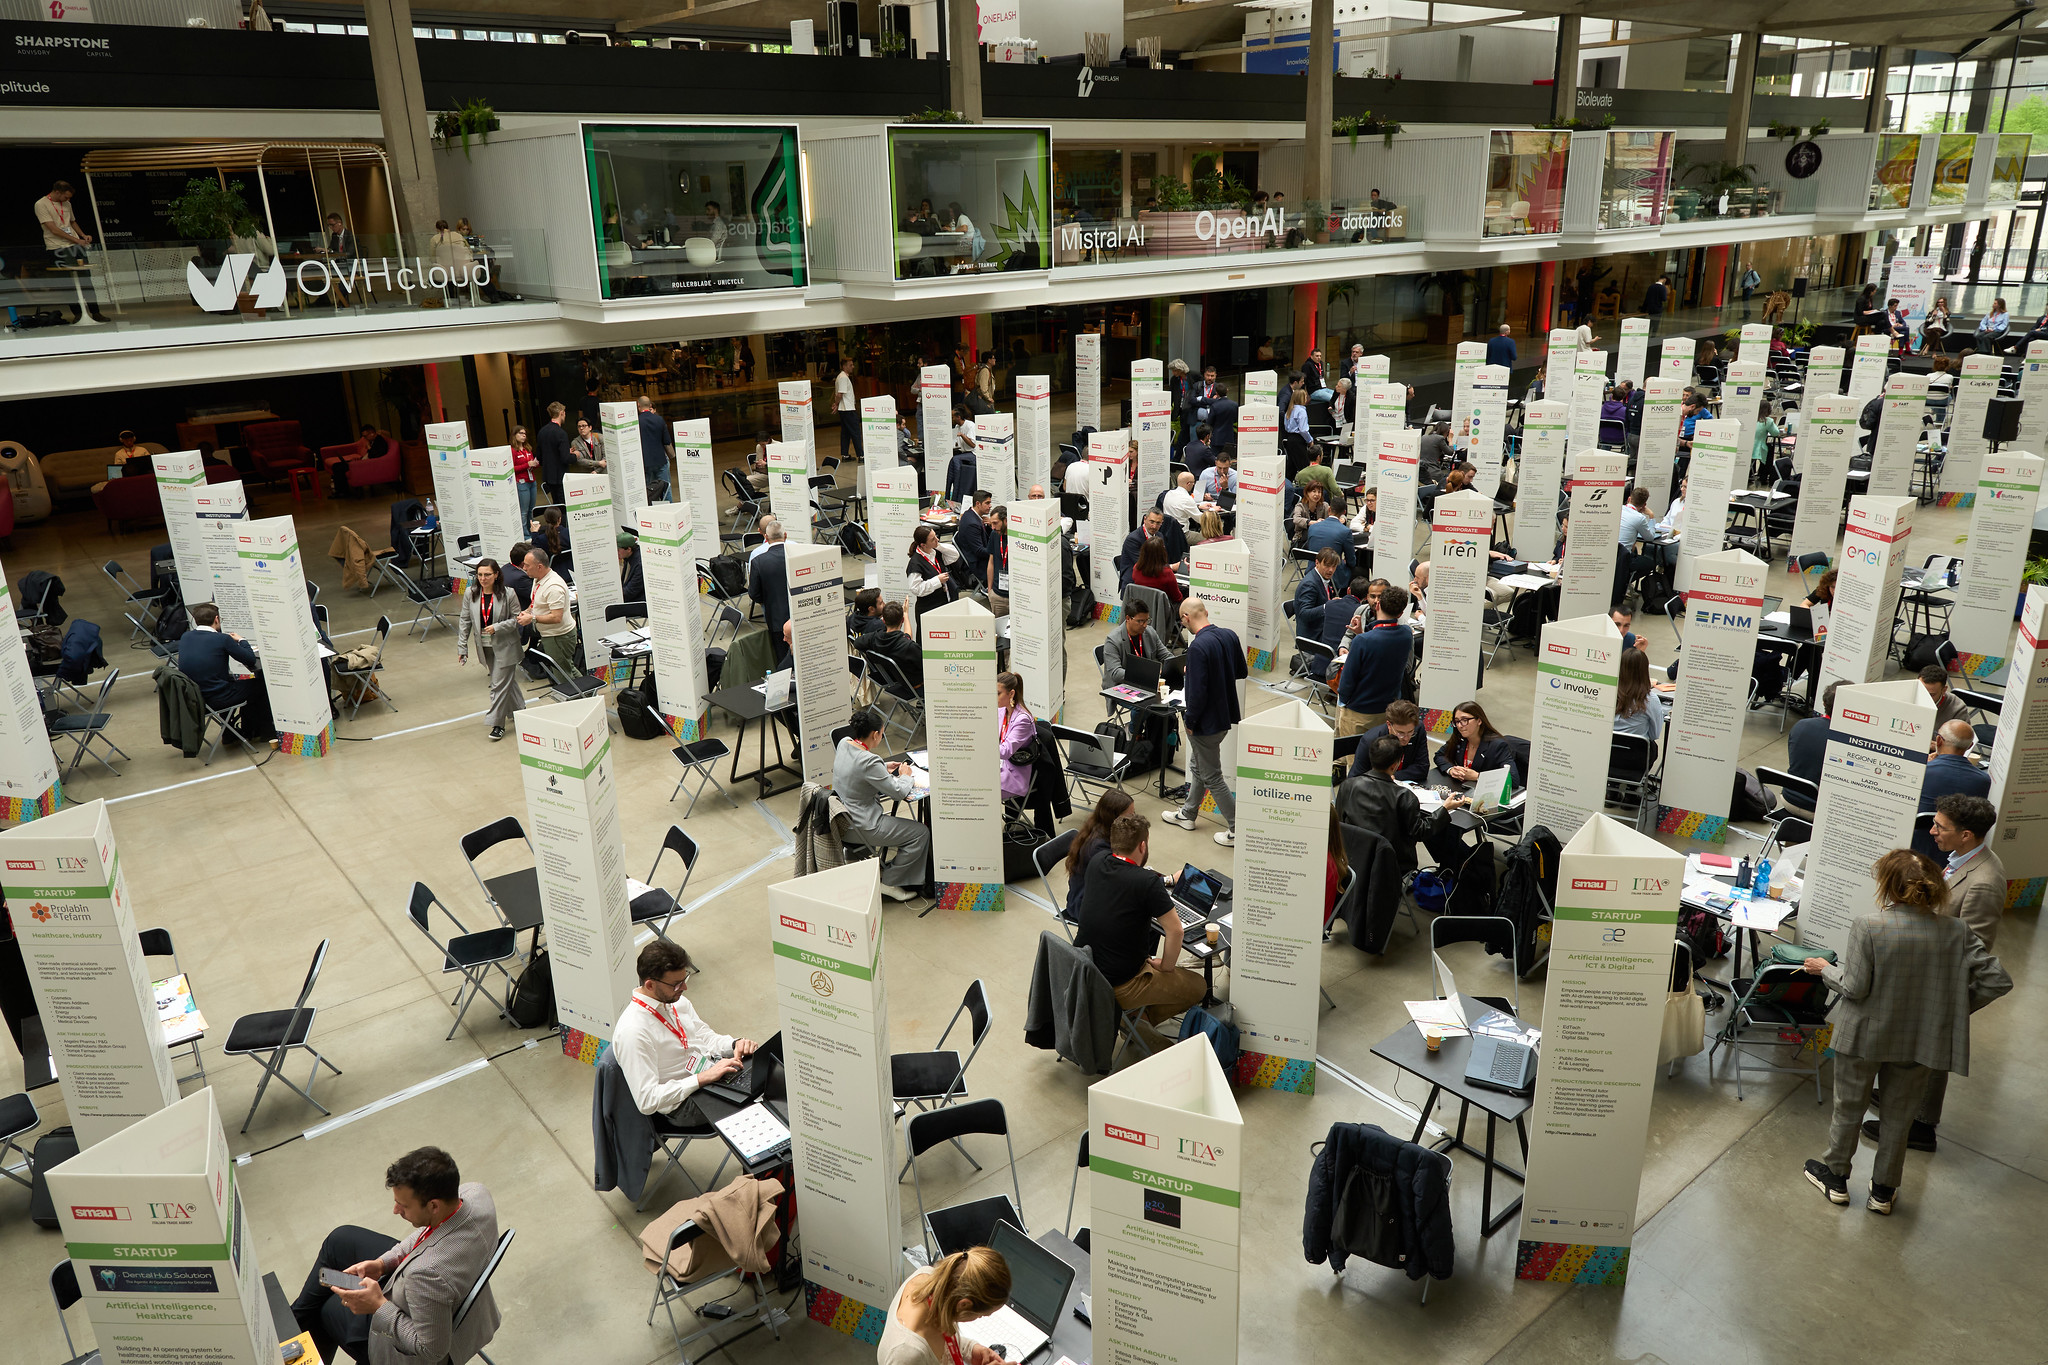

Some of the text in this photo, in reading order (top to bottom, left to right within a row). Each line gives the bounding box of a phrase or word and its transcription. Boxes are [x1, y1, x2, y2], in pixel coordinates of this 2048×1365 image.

[982, 10, 1017, 25] ONEFLASH
[15, 35, 110, 49] SHARPSTONE
[0, 80, 50, 94] plitude
[1576, 90, 1613, 107] Biolevate
[1194, 207, 1284, 248] OpenAI
[1341, 211, 1403, 231] databricks
[1061, 224, 1145, 251] Mistral AI
[978, 261, 999, 269] TRAMWAY
[296, 253, 491, 297] OVHcloud
[671, 279, 713, 289] ROLLERBLADE
[717, 277, 745, 287] UNICYCLE
[1386, 455, 1409, 463] CORPORATE
[1384, 471, 1408, 479] LACTALIS
[478, 479, 495, 487] TMT
[1246, 484, 1268, 492] CORPORATE
[2001, 493, 2024, 501] Butterfly
[1855, 527, 1881, 539] CORPORATE
[1443, 544, 1477, 558] iren
[1847, 545, 1881, 567] enel
[802, 580, 834, 593] INSTITUTION
[1205, 581, 1231, 589] STARTUP
[1196, 592, 1240, 605] MatchGuru
[1704, 593, 1747, 604] CORPORATE
[1711, 612, 1752, 629] FNM
[1718, 626, 1750, 634] movimento
[944, 664, 975, 673] BIOTECH
[1560, 668, 1593, 680] STARTUP
[1542, 701, 1605, 719] Emerging Technologies
[1545, 696, 1602, 713] Artificial Intelligence,
[1844, 710, 1916, 733] smau ITA
[1249, 745, 1318, 759] smau ITA
[1848, 736, 1905, 757] INSTITUTION
[537, 760, 564, 774] STARTUP
[1846, 751, 1901, 771] REGIONE LAZIO
[1264, 771, 1303, 782] STARTUP
[1861, 777, 1879, 786] LAZIO
[1823, 772, 1916, 802] REGIONAL INNOVATION ECOSYSTEM
[1253, 786, 1313, 803] iotilize.me
[1268, 815, 1295, 824] Industry
[1279, 809, 1302, 818] Digital,
[8, 857, 84, 870] smau ITA
[1573, 877, 1663, 891] smau ITA
[33, 889, 77, 897] STARTUP
[50, 904, 90, 914] Prolabin
[1591, 911, 1642, 921] STARTUP
[32, 932, 103, 940] Healthcare, Industry
[781, 917, 853, 944] smau ITA
[800, 952, 841, 970] STARTUP
[1567, 953, 1655, 964] Artificial Intelligence,
[1608, 963, 1635, 971] Digital
[790, 991, 860, 1019] Artificial Intelligence,
[811, 1006, 838, 1021] Mobility
[1106, 1126, 1217, 1162] smau ITA
[1132, 1170, 1194, 1193] STARTUP
[74, 1202, 190, 1219] smau ITA
[1121, 1229, 1204, 1256] Emerging Technologies
[1125, 1223, 1200, 1249] Artificial Intelligence,
[113, 1247, 178, 1258] STARTUP
[1107, 1248, 1137, 1261] MISSION
[122, 1271, 153, 1279] Dental
[1107, 1258, 1212, 1293] Making quantum computing practical
[105, 1301, 217, 1312] Artificial Intelligence,
[136, 1312, 193, 1320] Healthcare
[116, 1345, 141, 1353] Building
[160, 1346, 190, 1354] operating
